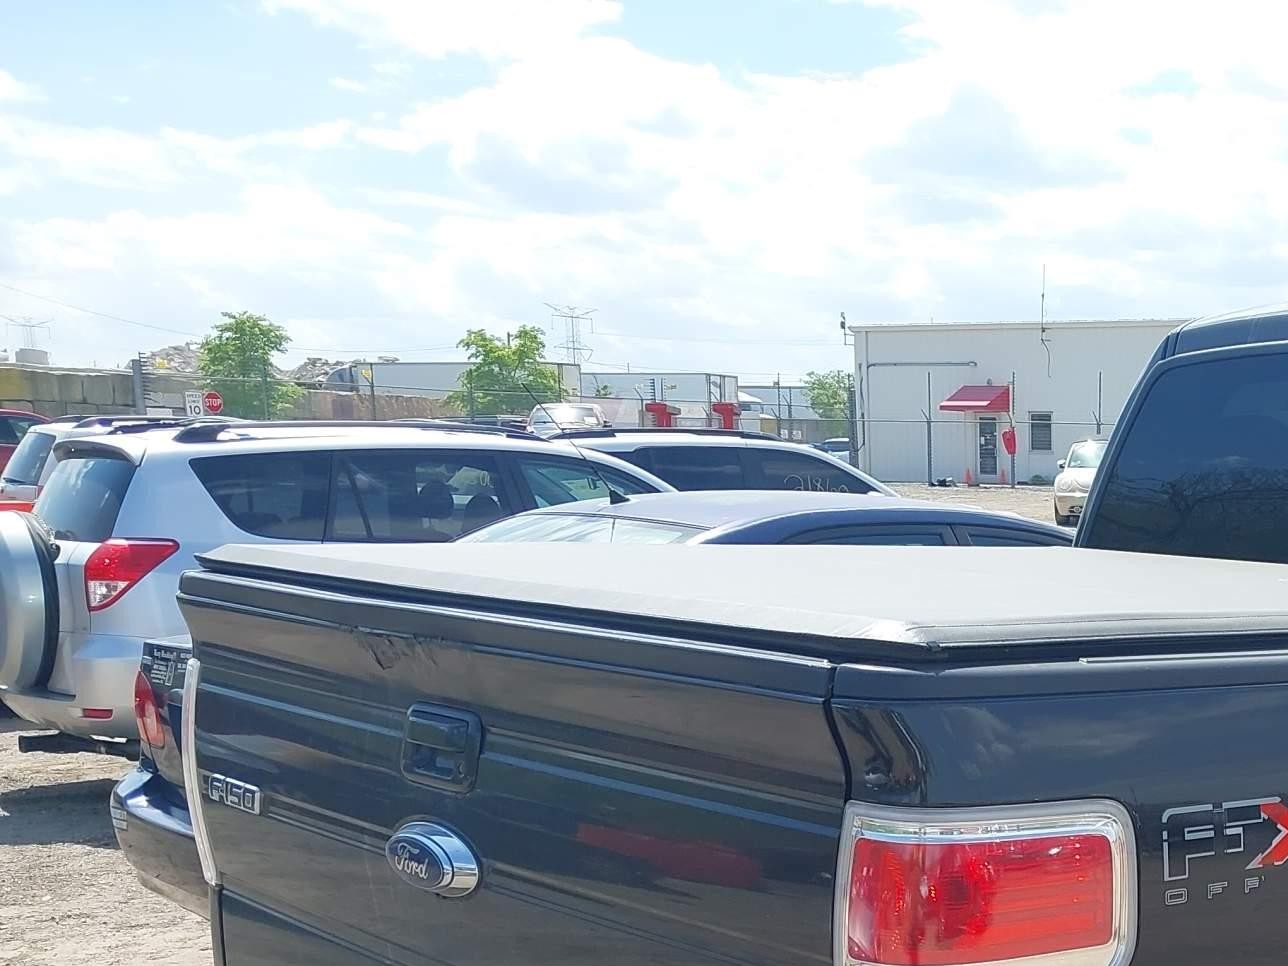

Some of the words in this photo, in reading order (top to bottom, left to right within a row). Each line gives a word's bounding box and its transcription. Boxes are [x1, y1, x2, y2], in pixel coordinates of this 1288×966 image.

[189, 405, 201, 415] 10
[205, 399, 221, 407] STOP
[395, 842, 429, 879] Ford
[1165, 876, 1265, 906] OFF
